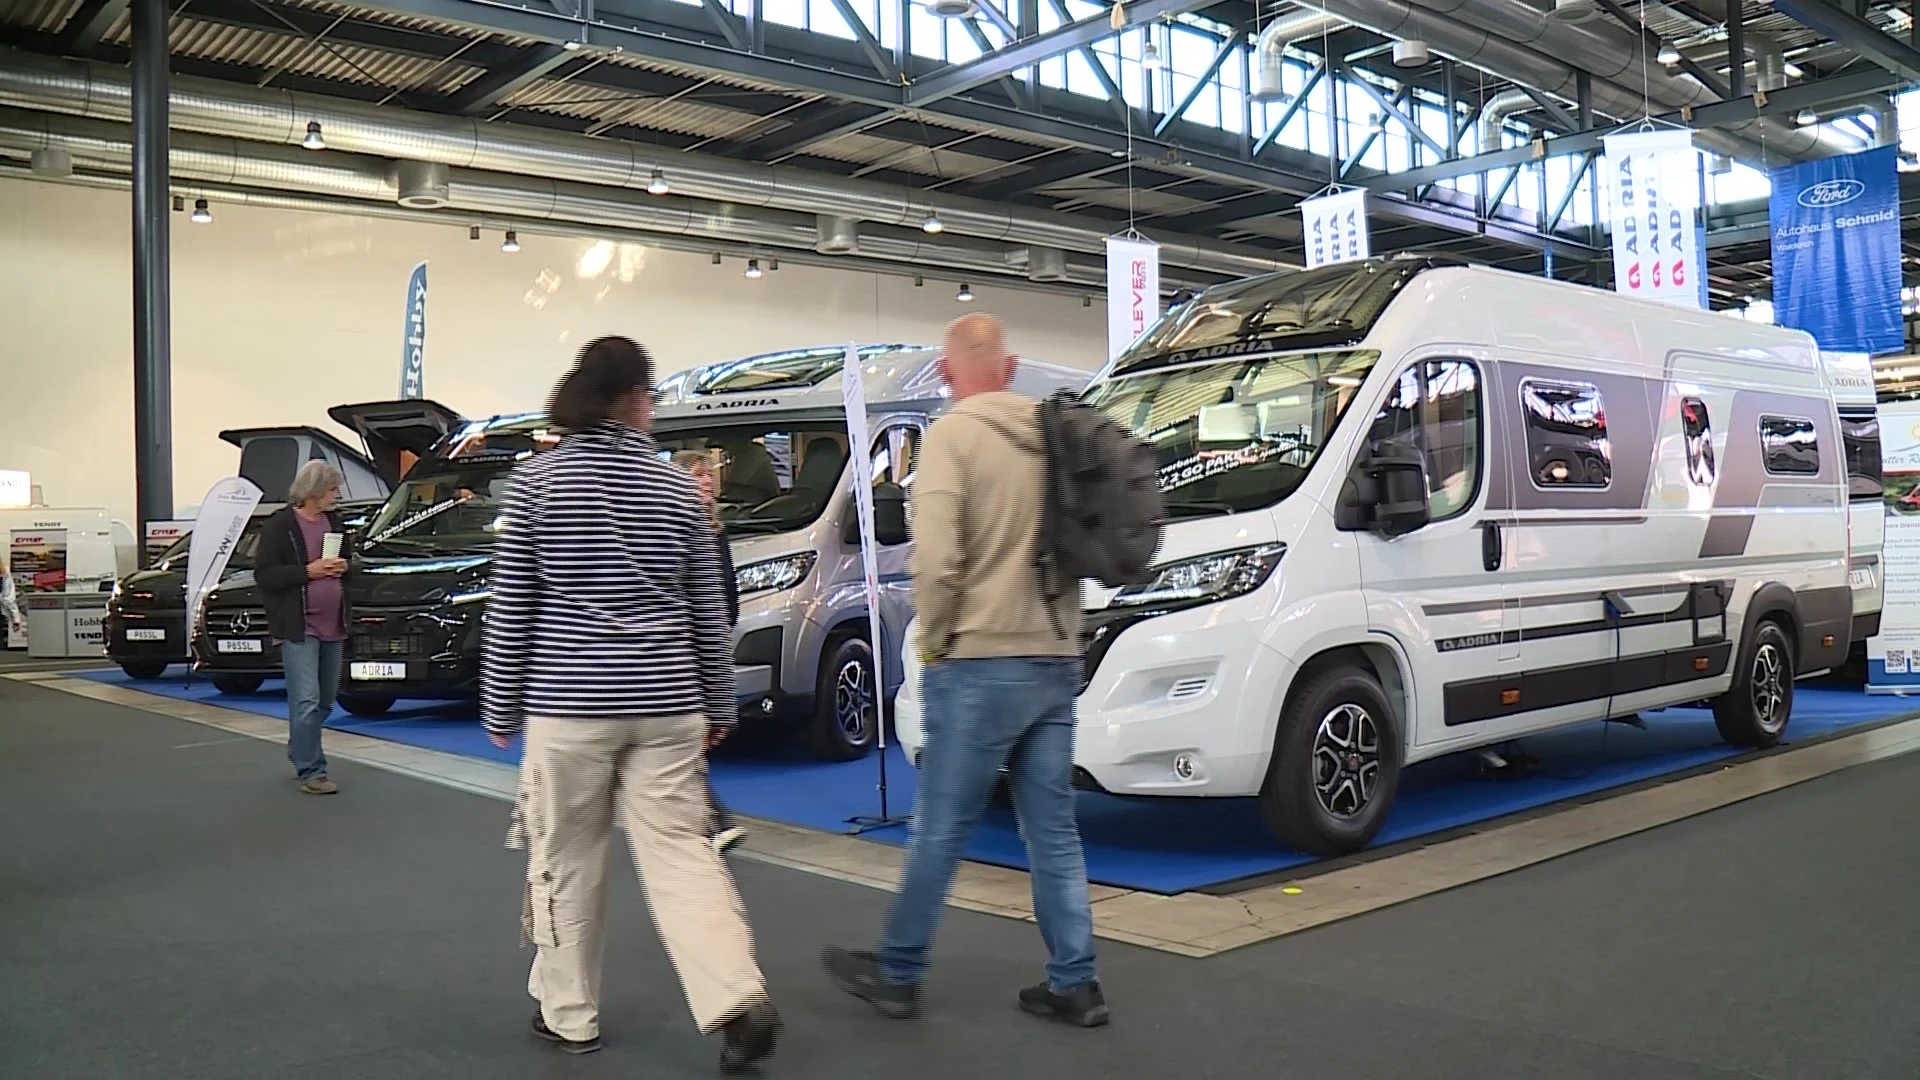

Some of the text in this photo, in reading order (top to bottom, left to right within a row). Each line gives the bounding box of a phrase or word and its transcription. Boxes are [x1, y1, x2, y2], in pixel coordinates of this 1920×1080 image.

[1810, 184, 1851, 203] Ford
[1620, 155, 1638, 256] ADRIA
[1776, 209, 1894, 238] Autohaus Schmid
[1132, 260, 1144, 340] LEVER
[407, 277, 427, 398] Hobby
[1191, 340, 1274, 360] ADRIA
[715, 398, 780, 409] ADRIA
[1181, 464, 1203, 479] GO
[74, 617, 103, 627] Hobb
[74, 632, 102, 640] FEND
[1457, 633, 1499, 649] ADRIA
[361, 664, 394, 677] ADRIA
